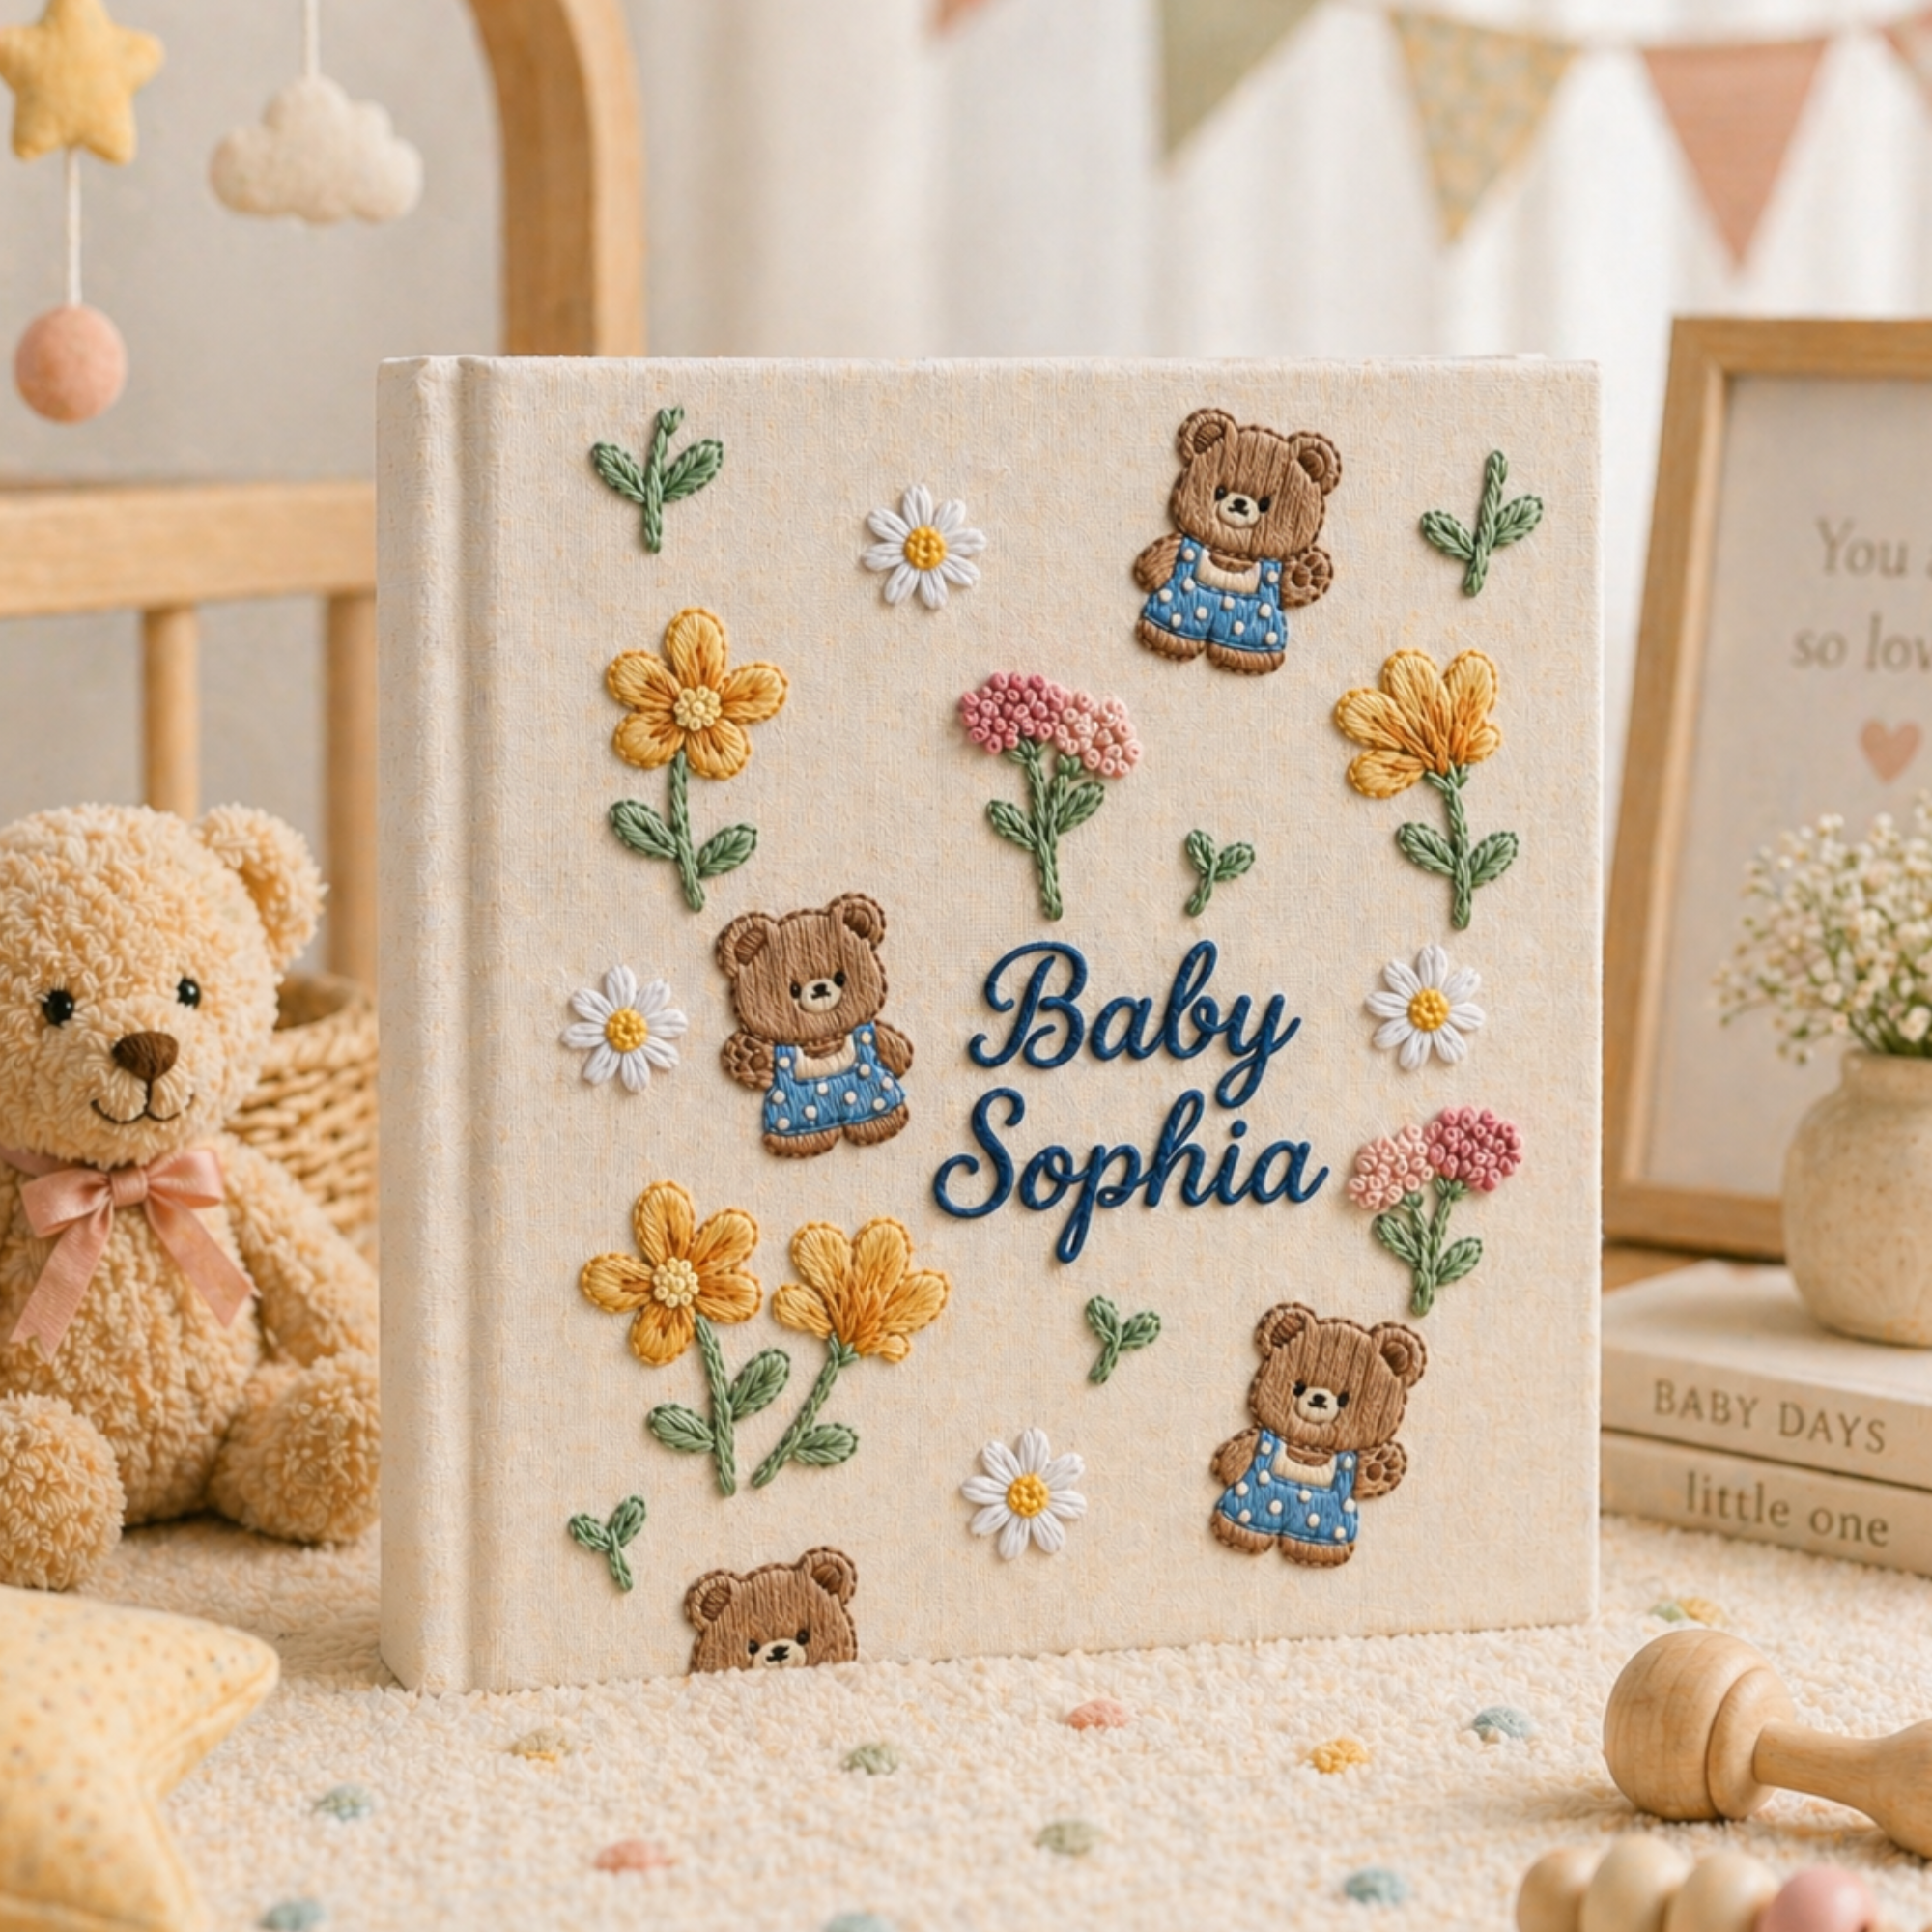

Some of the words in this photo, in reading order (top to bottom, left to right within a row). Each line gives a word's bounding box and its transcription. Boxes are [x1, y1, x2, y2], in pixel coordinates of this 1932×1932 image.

[1816, 516, 1909, 577] You
[1791, 629, 1848, 670] so
[969, 940, 1302, 1108] Baby
[933, 1087, 1329, 1264] Sophia
[1654, 1378, 1759, 1429] BABY
[1778, 1401, 1887, 1454] DAYS
[1687, 1469, 1790, 1528] little
[1808, 1506, 1889, 1547] one
